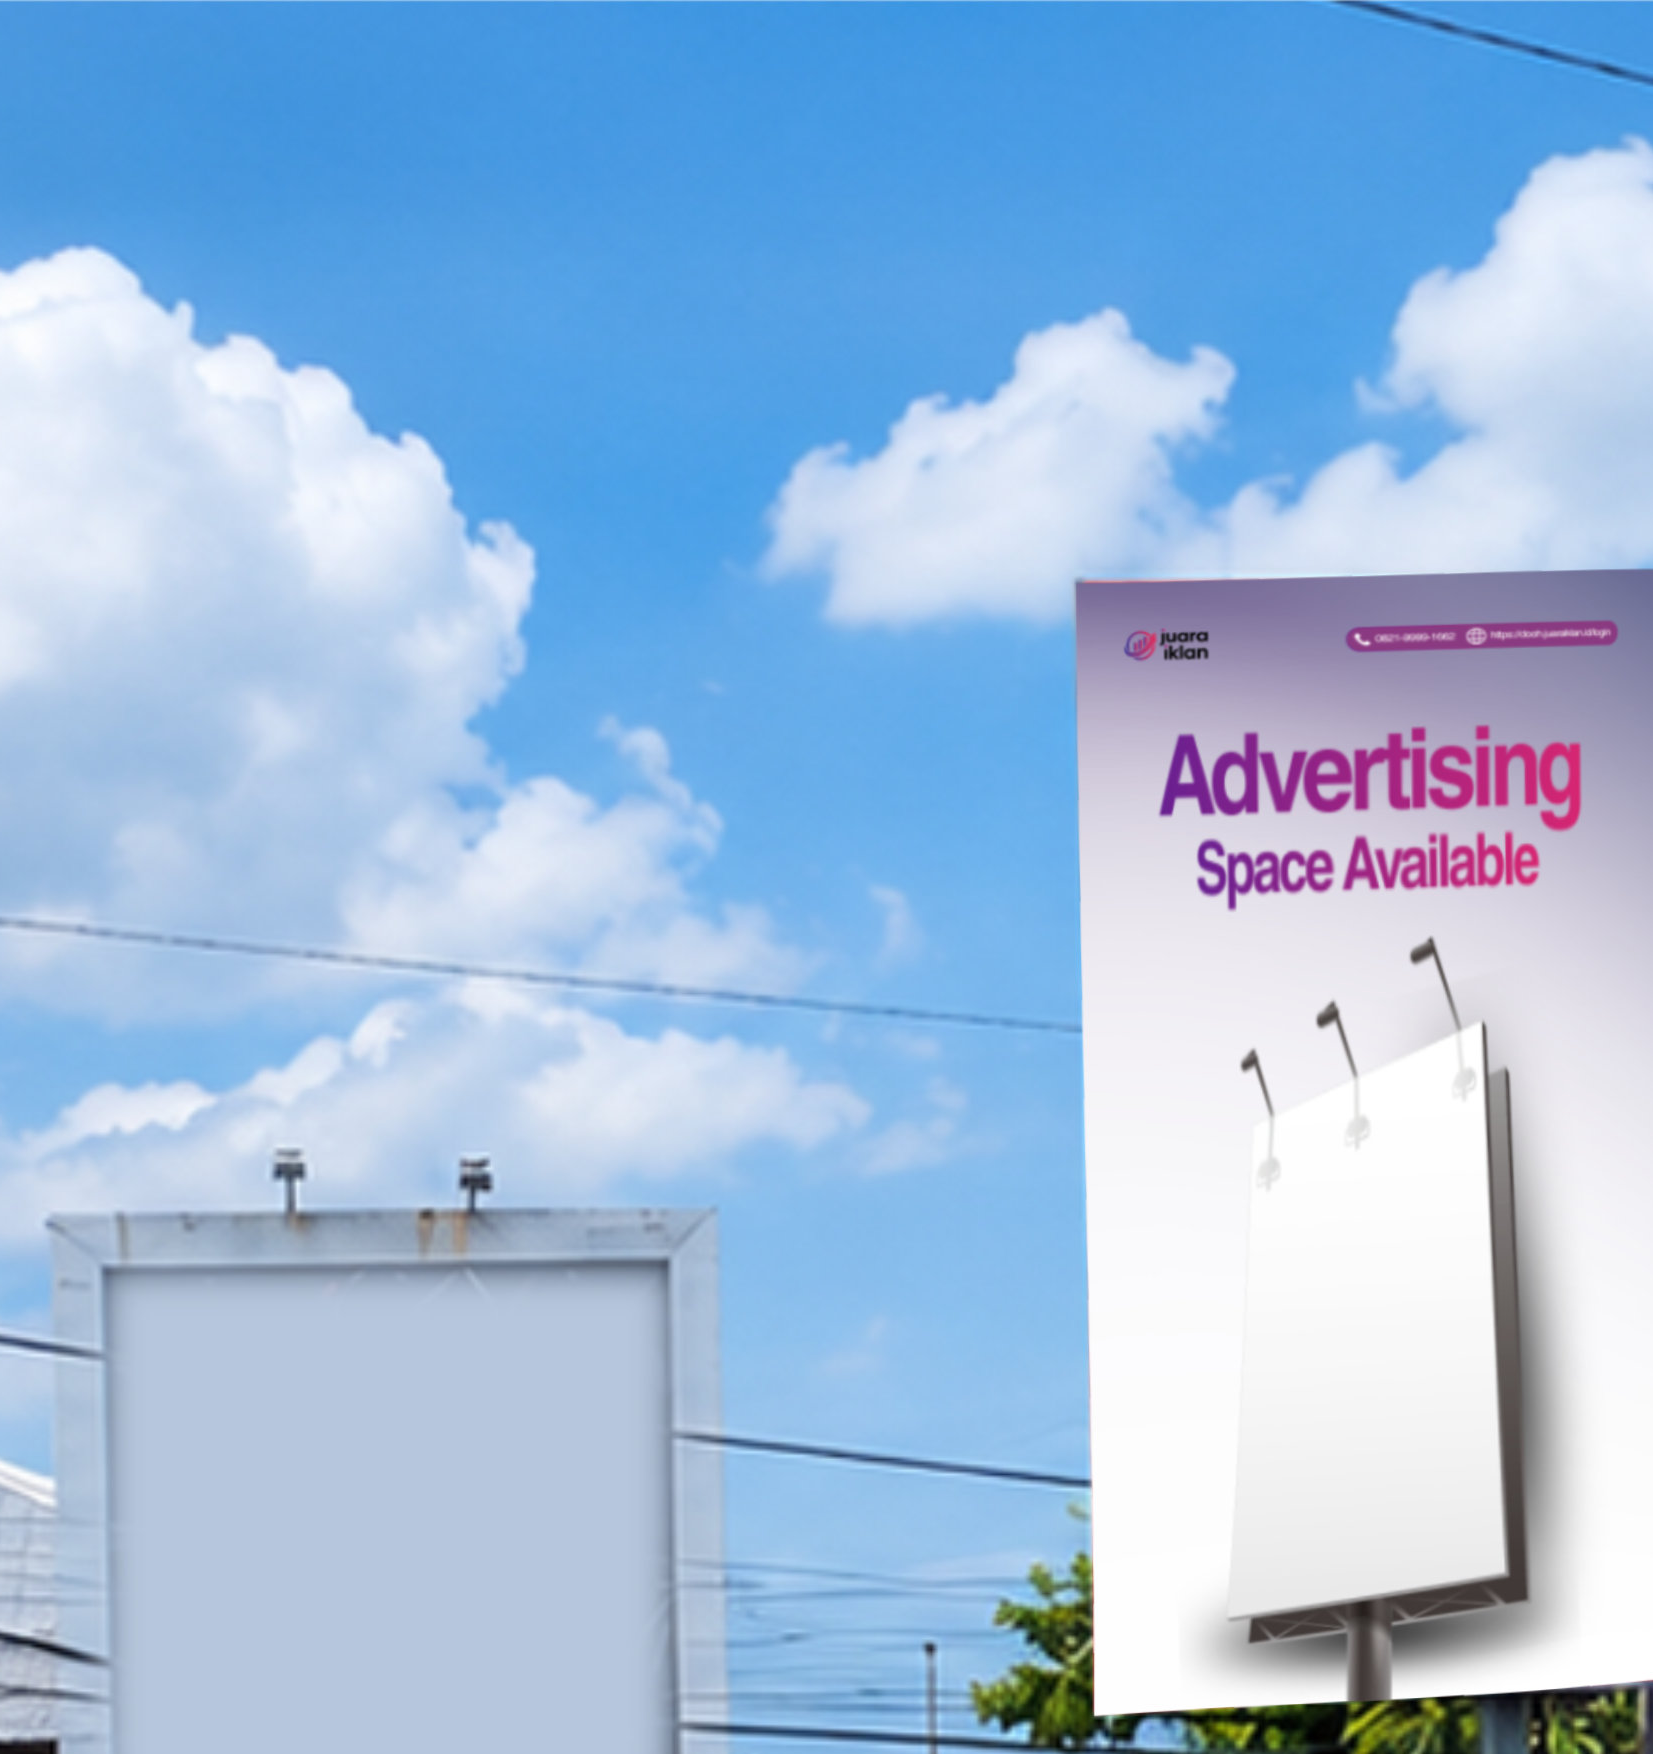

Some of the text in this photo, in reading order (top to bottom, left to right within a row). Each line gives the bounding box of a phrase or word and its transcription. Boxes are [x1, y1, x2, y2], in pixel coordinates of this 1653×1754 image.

[1160, 628, 1209, 645] juara
[1164, 644, 1209, 660] iklan
[1160, 725, 1582, 831] Advertising
[1197, 831, 1540, 911] Space Available
